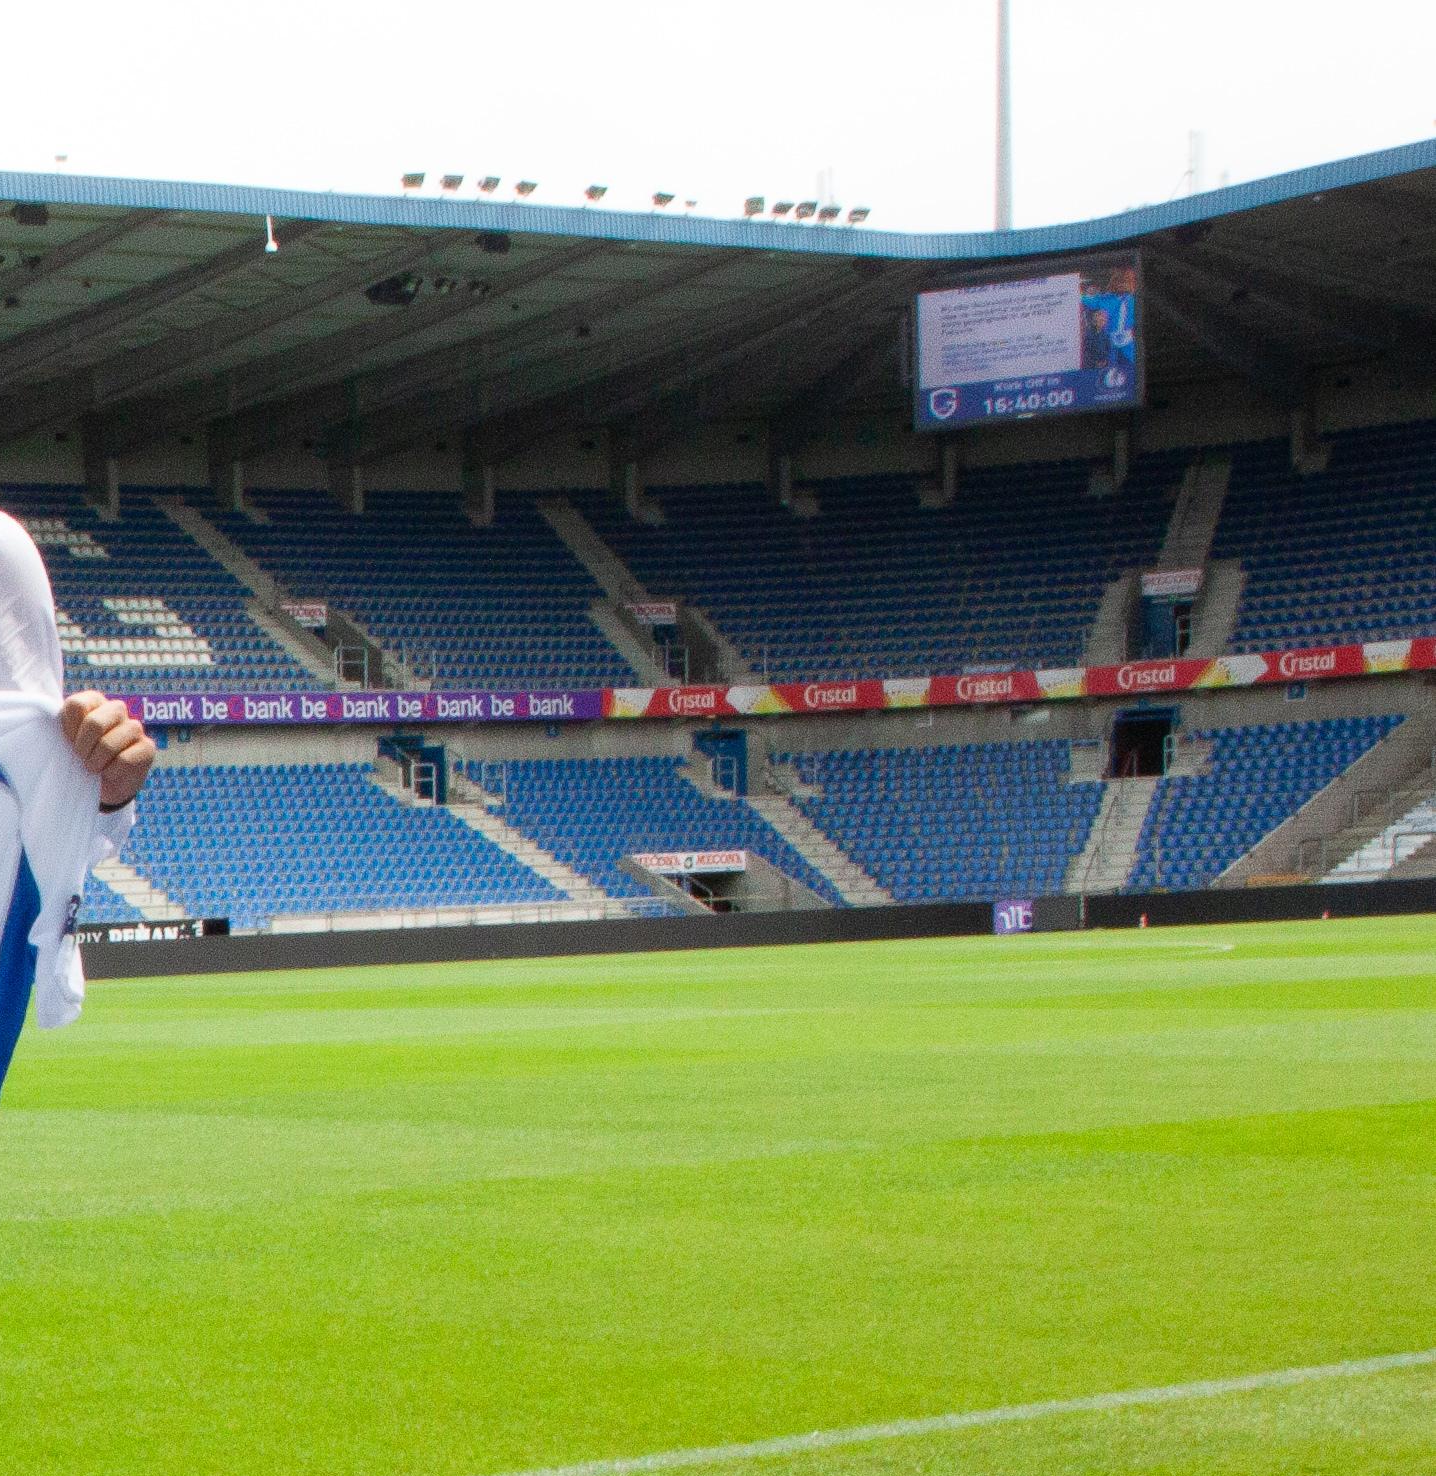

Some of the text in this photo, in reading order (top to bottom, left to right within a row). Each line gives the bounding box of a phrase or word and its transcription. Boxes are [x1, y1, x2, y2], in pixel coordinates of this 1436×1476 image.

[984, 389, 1076, 415] 16:40:00
[1278, 650, 1337, 676] Cristal
[955, 675, 1014, 701] Cristal
[1116, 663, 1176, 691] Cristal
[667, 688, 716, 713] Cristal
[803, 684, 857, 708] Cristal
